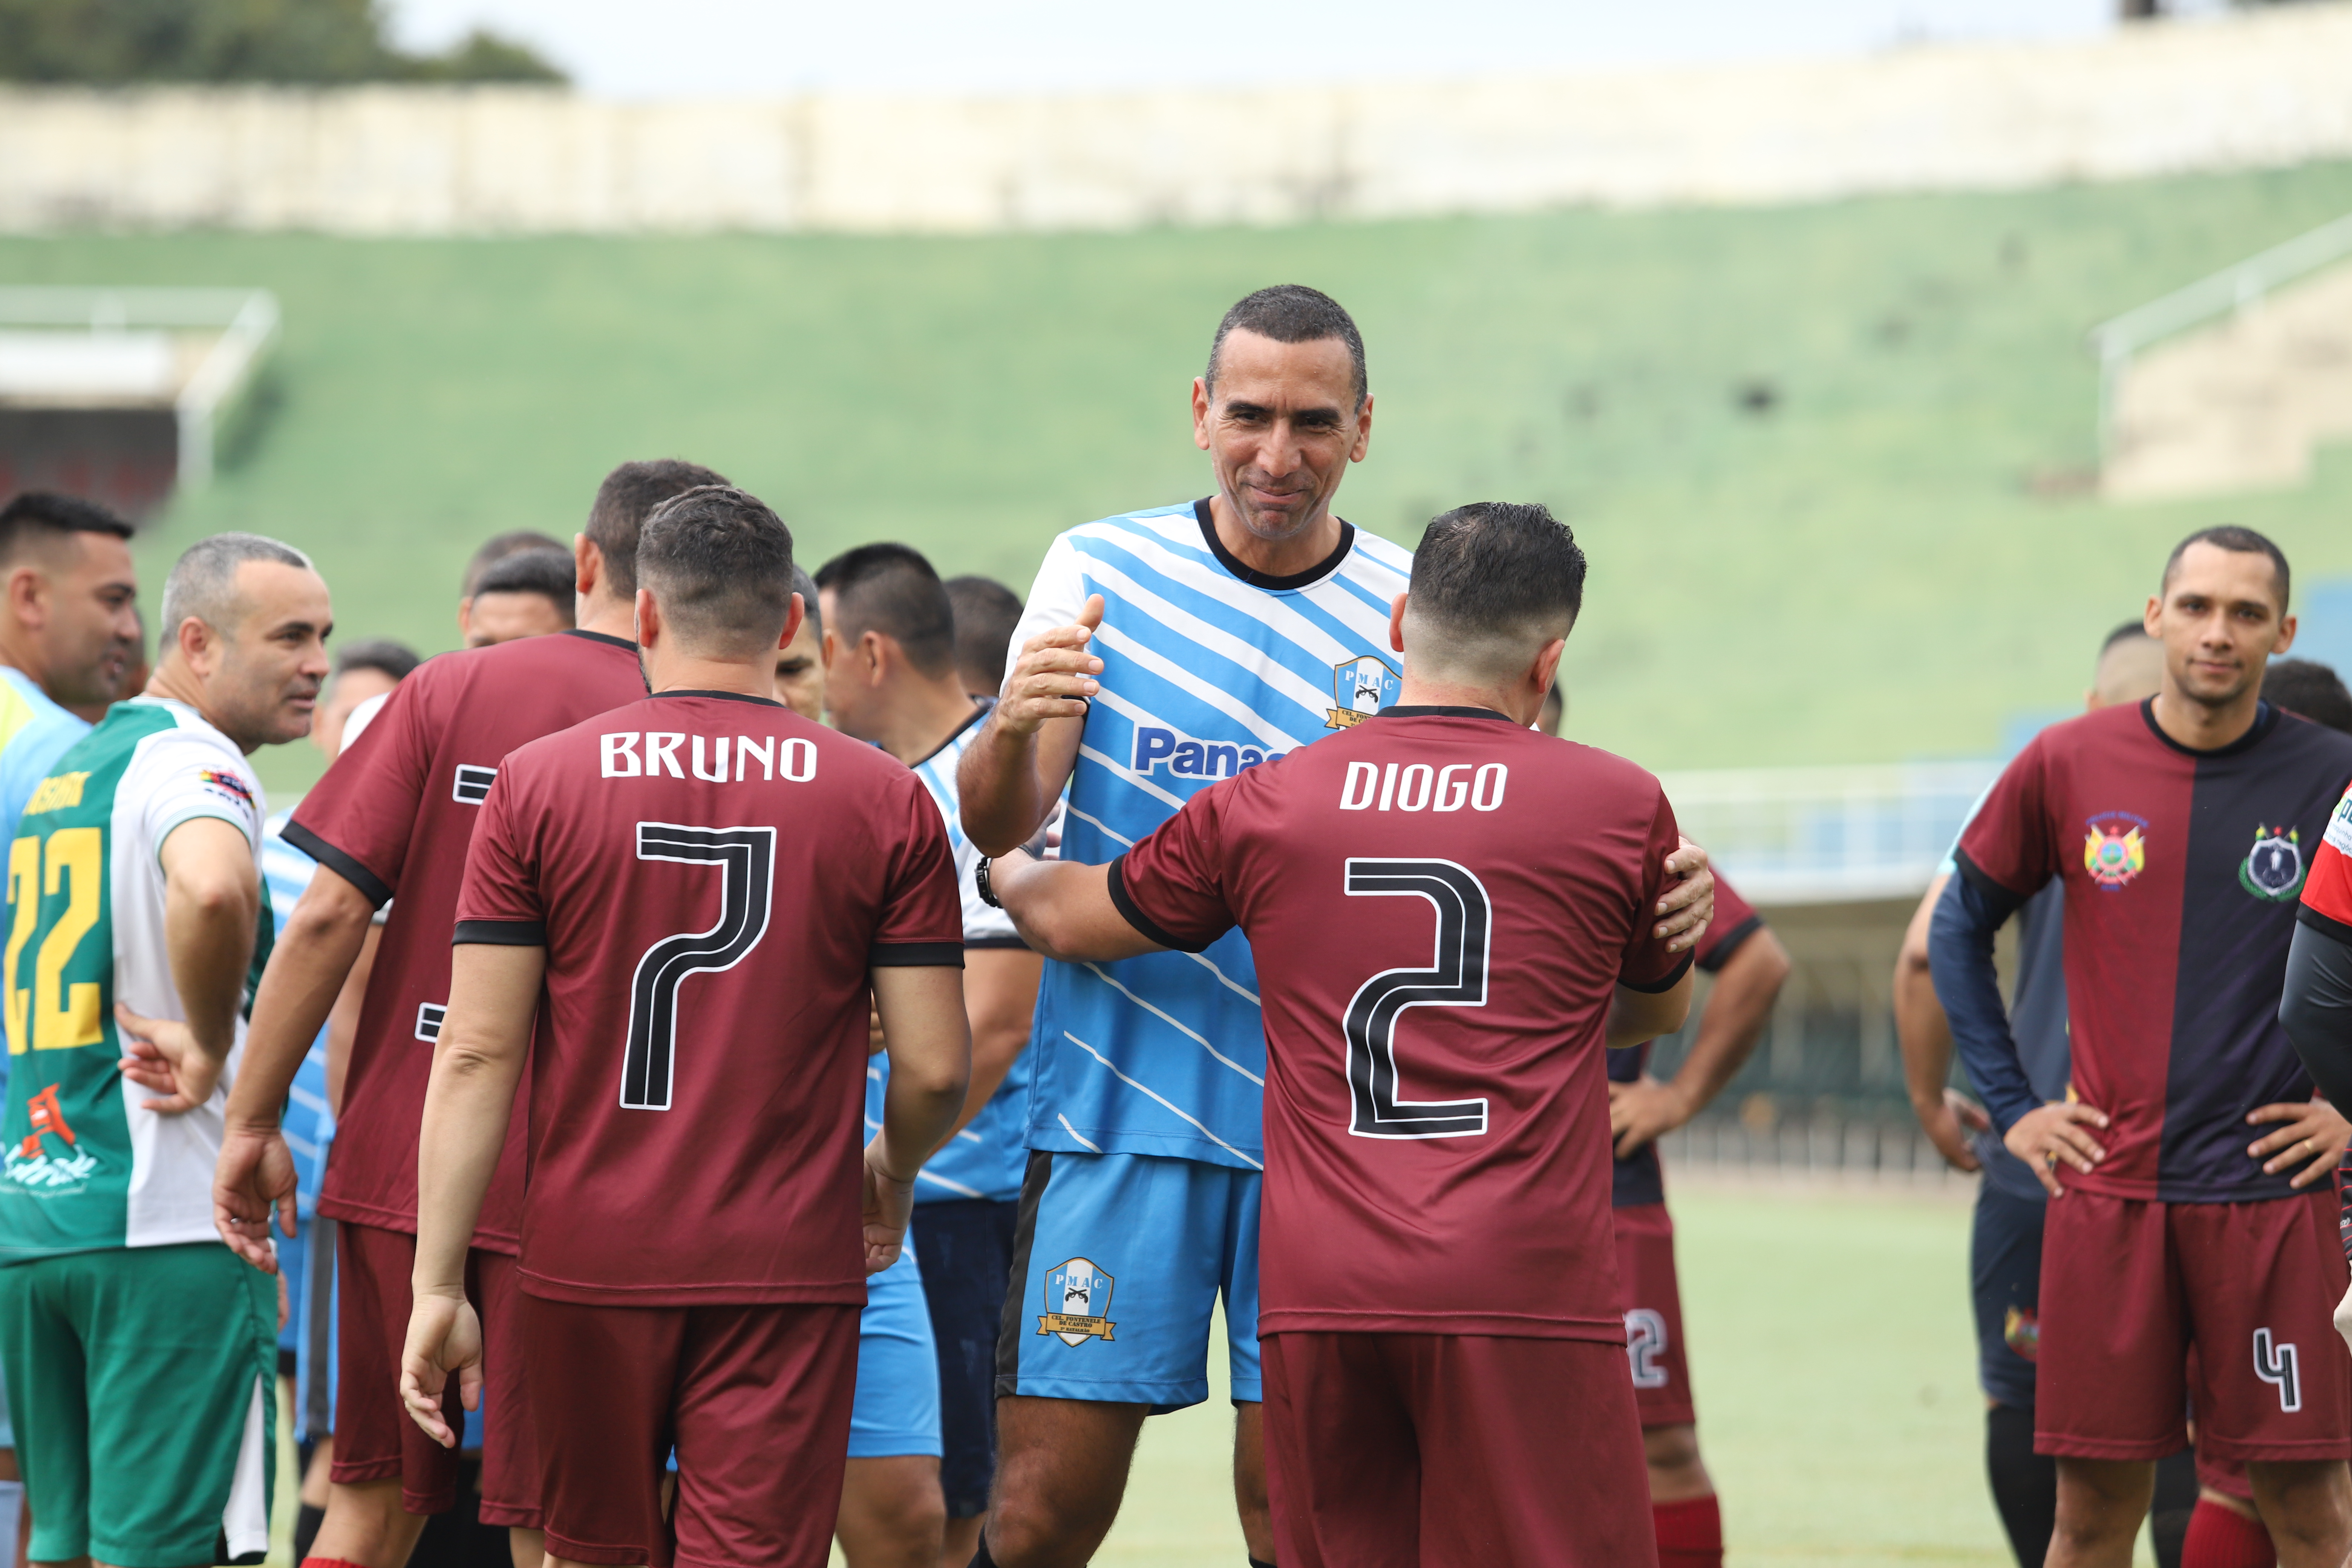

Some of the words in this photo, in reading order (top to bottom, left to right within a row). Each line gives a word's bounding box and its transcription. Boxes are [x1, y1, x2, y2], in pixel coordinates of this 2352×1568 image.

[1345, 670, 1393, 690] PMAC
[600, 732, 818, 783] BRUNO
[1135, 727, 1286, 777] Pana
[1339, 761, 1508, 812] DIOGO
[3, 827, 104, 1055] 22
[619, 821, 777, 1111] 7
[1342, 857, 1492, 1140] 2
[1055, 1274, 1103, 1289] PMAC
[2253, 1326, 2301, 1413] 4
